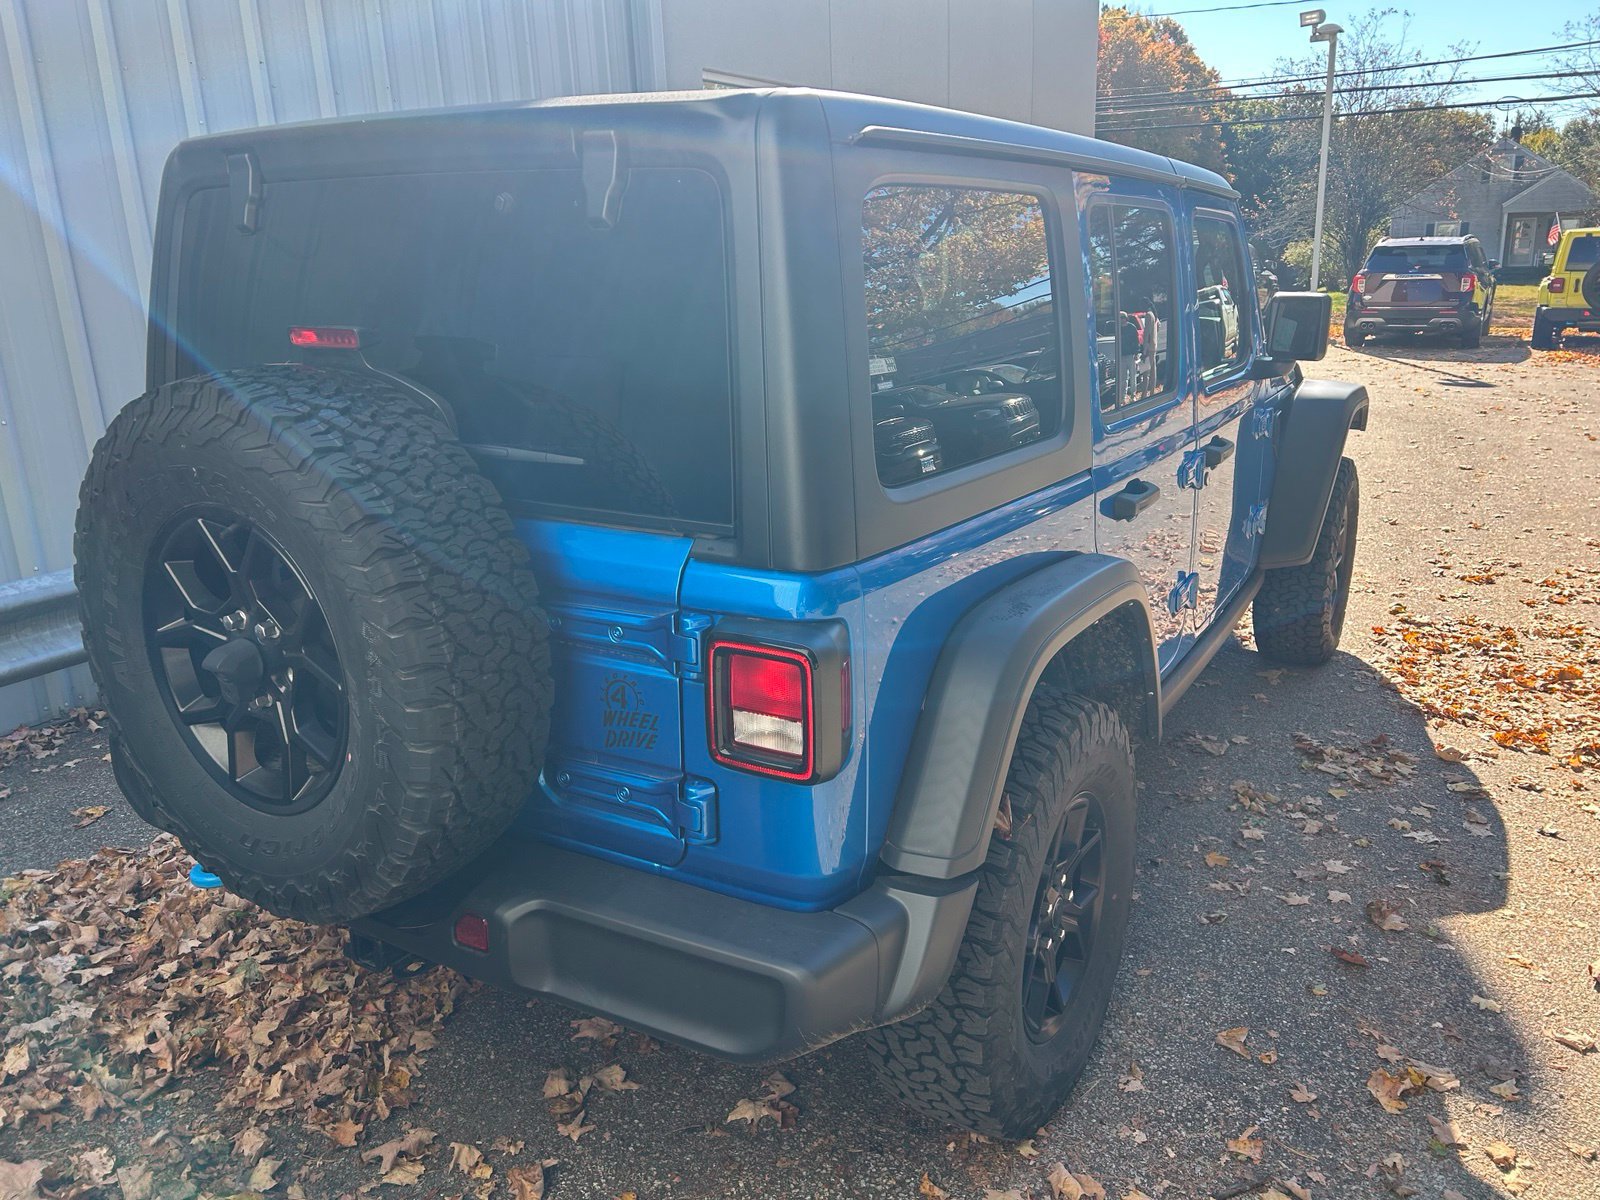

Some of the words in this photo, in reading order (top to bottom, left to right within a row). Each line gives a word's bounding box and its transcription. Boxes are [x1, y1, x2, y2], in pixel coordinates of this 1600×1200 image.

[611, 685, 627, 709] 4
[604, 710, 659, 730] WHEEL
[604, 729, 658, 749] DRIVE
